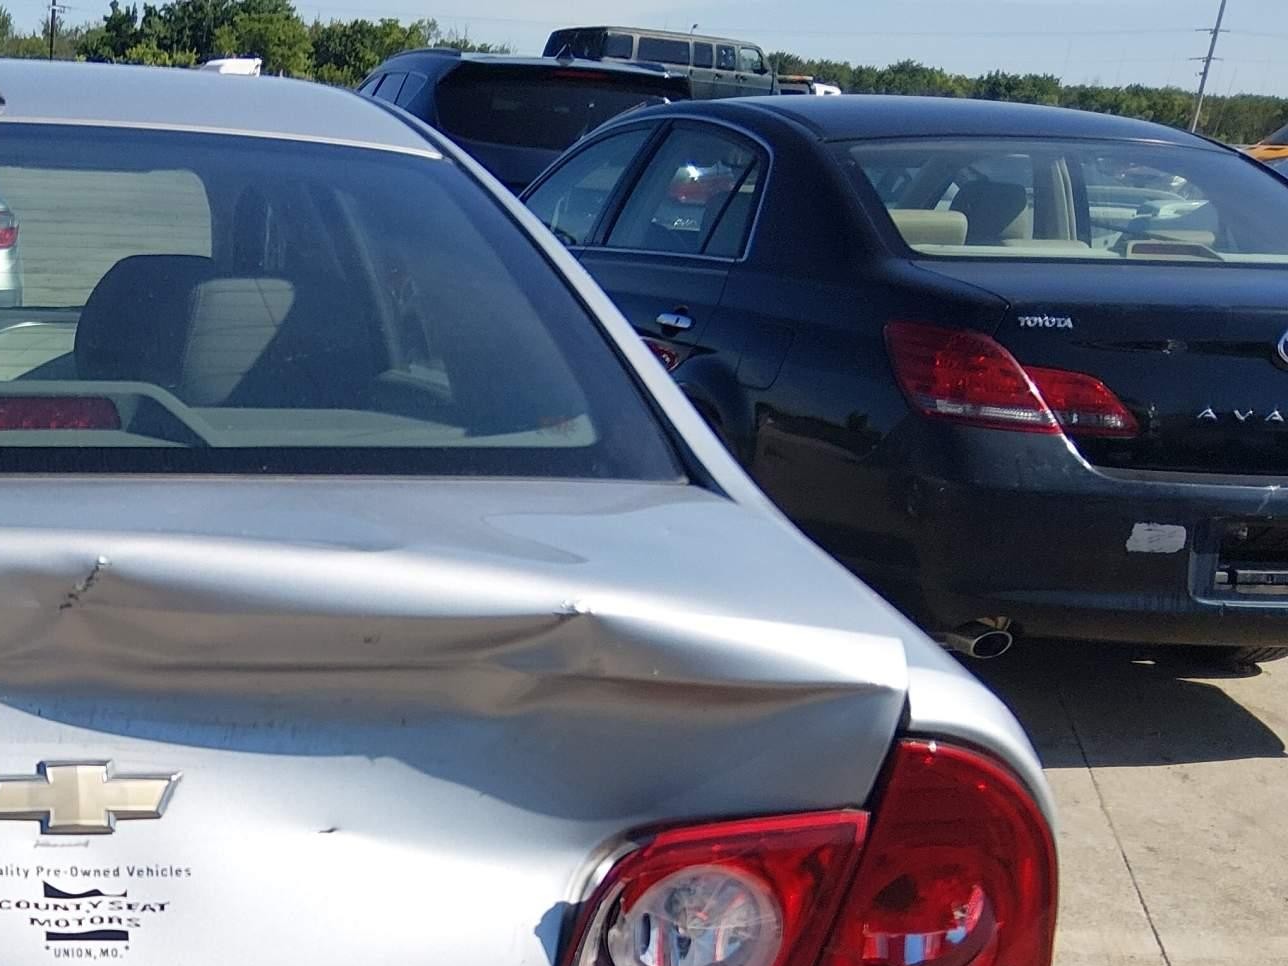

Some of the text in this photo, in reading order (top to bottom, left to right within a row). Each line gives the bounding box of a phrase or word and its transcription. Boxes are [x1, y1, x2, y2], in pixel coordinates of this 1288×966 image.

[1017, 313, 1074, 329] TOYOTA
[35, 865, 120, 878] Pre-Owned
[125, 865, 192, 878] Vehicles
[108, 900, 171, 913] SEAT
[29, 915, 142, 929] MOTORS
